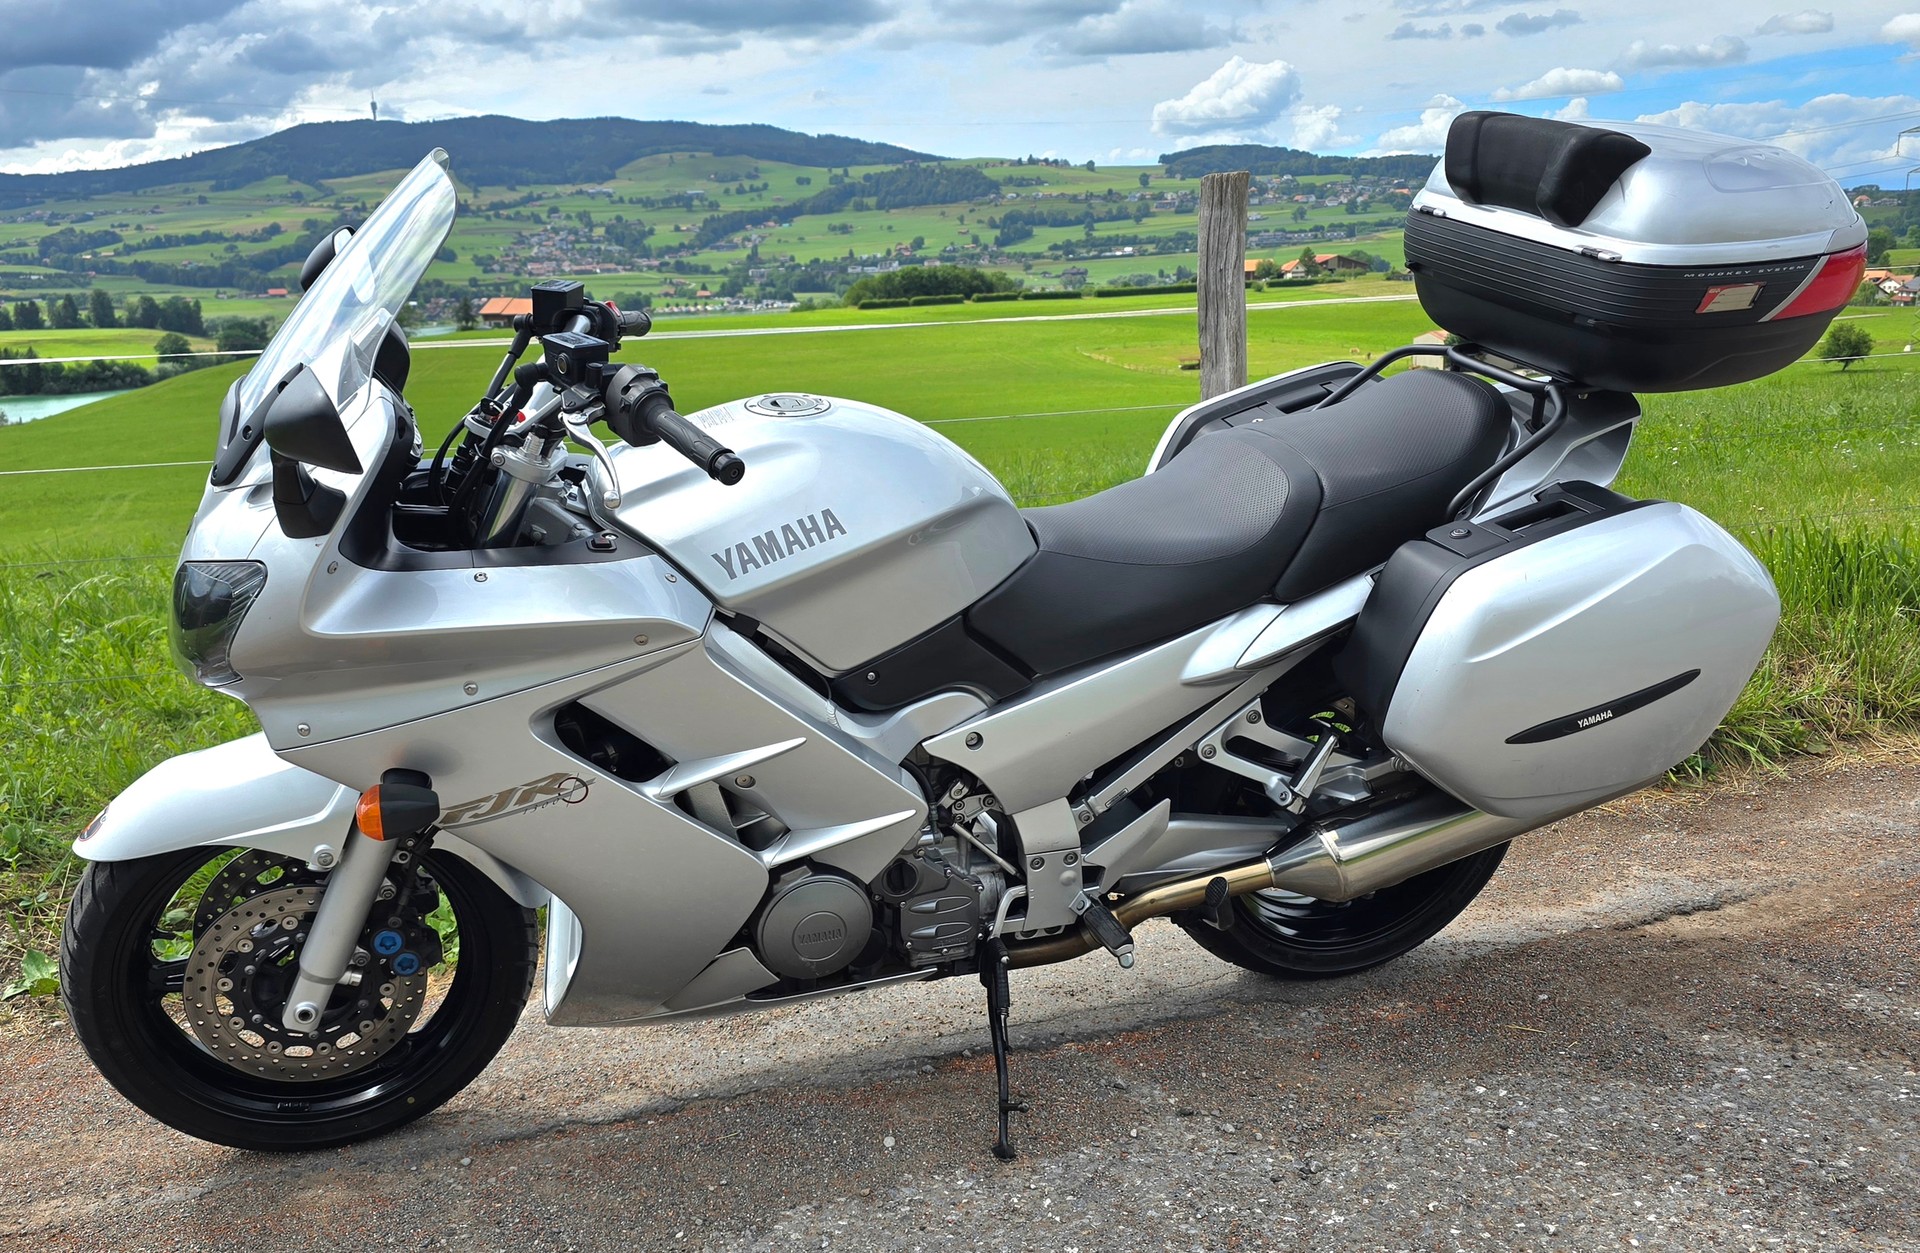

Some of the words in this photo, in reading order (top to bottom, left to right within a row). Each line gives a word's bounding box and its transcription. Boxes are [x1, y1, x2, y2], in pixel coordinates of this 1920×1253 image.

[1684, 269, 1752, 278] MONOKEY
[1758, 264, 1805, 274] SYSTEM
[711, 507, 848, 580] YAMAHA
[1577, 709, 1613, 728] YAMAHA
[438, 772, 573, 825] FJR
[799, 927, 843, 945] YAMAHA
